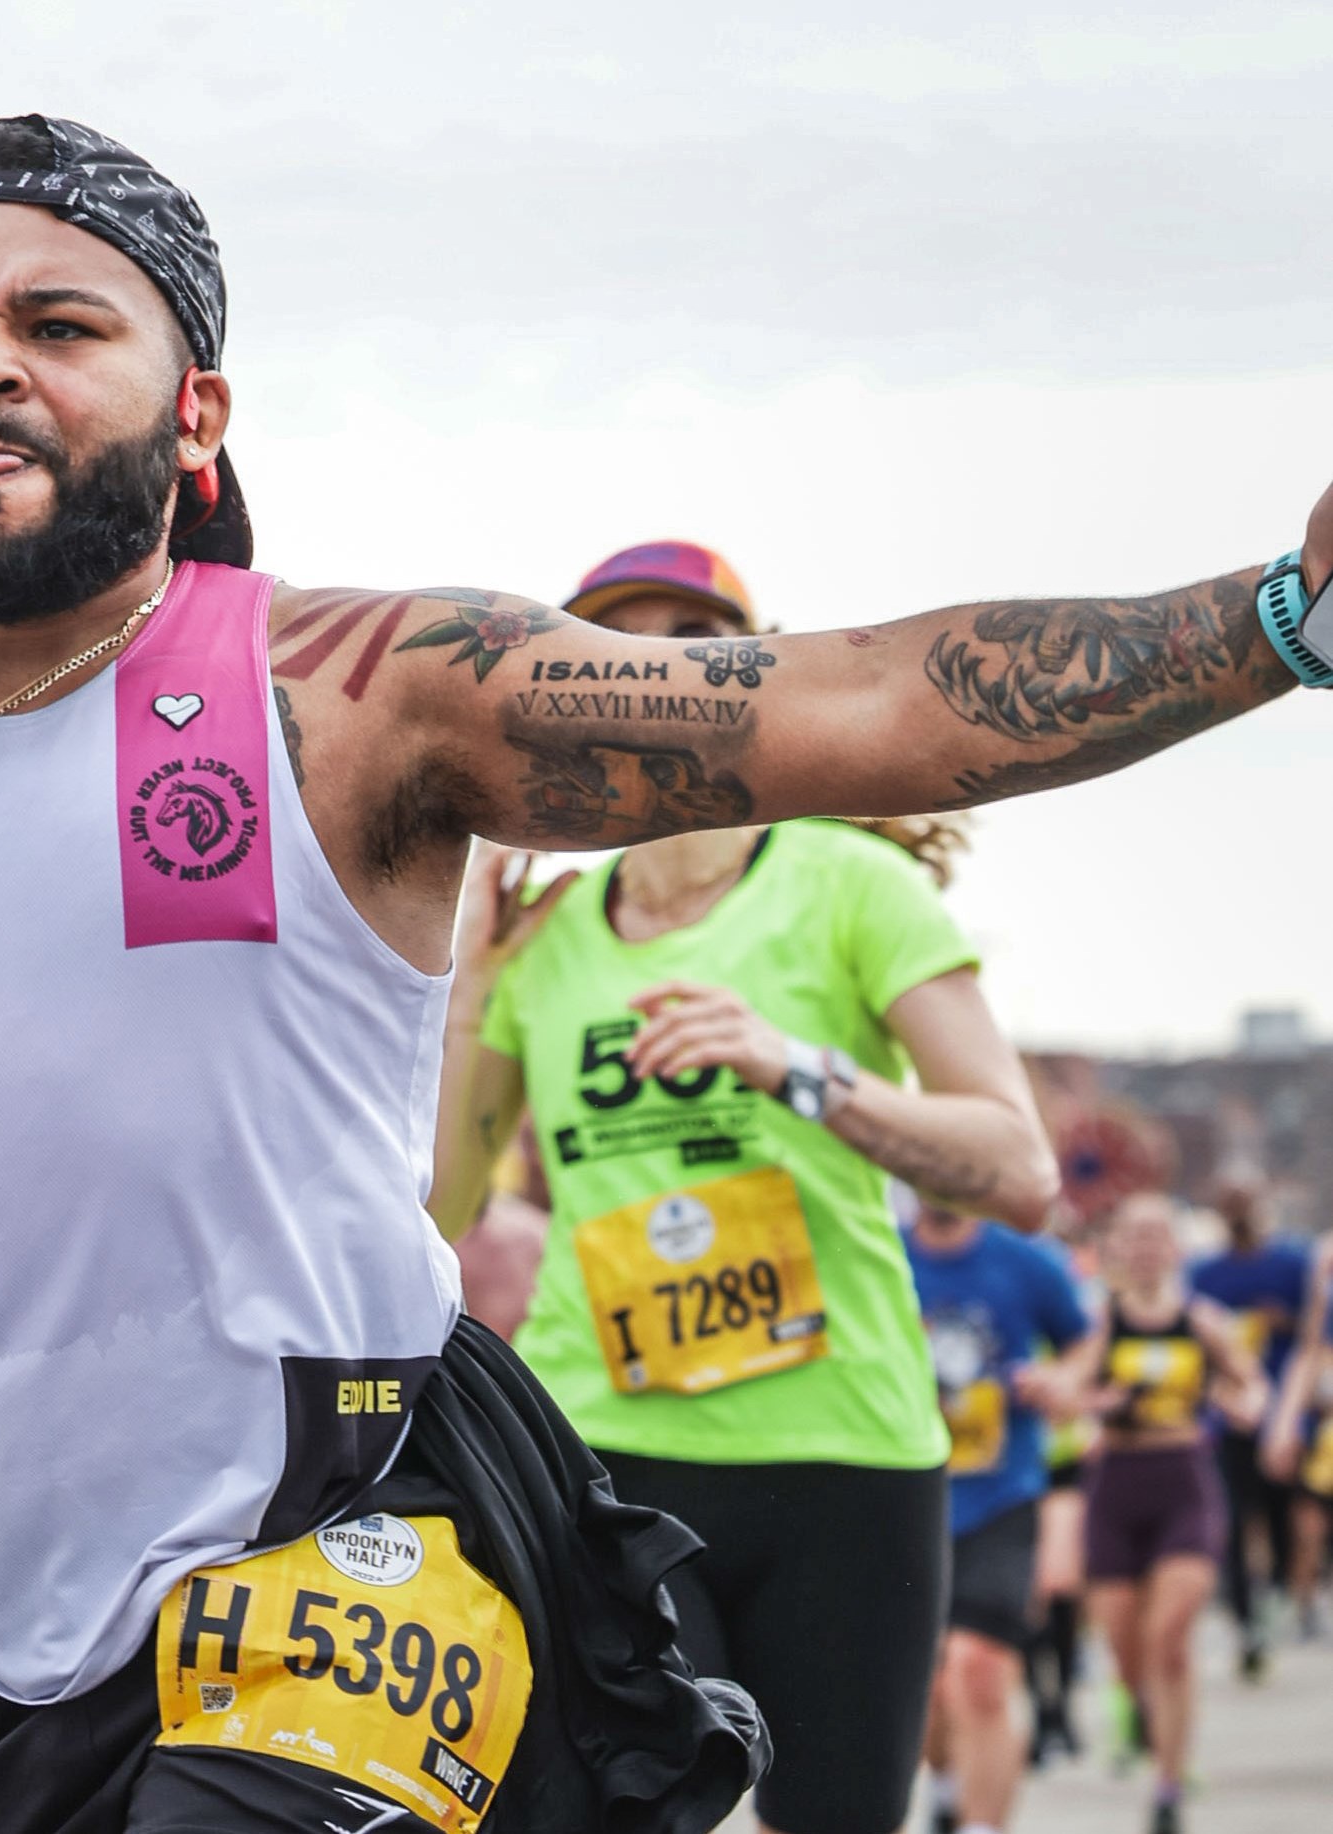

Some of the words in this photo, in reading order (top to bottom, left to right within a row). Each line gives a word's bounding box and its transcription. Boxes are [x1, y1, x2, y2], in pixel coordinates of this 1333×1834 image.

[531, 660, 668, 682] ISAIAH
[517, 688, 539, 717] V
[544, 691, 632, 719] XXVII
[641, 694, 748, 726] MMXIV
[136, 759, 184, 801] NEVER
[192, 757, 257, 809] PROJECT
[130, 805, 150, 843] QUIT
[142, 846, 176, 876] THE
[653, 1259, 781, 1346] 7289
[323, 1531, 416, 1561] BROOKLYN
[347, 1547, 391, 1569] HALF
[180, 1577, 251, 1673] H
[283, 1589, 481, 1743] 5398
[434, 1747, 474, 1796] WAVE
[467, 1778, 482, 1803] 1
